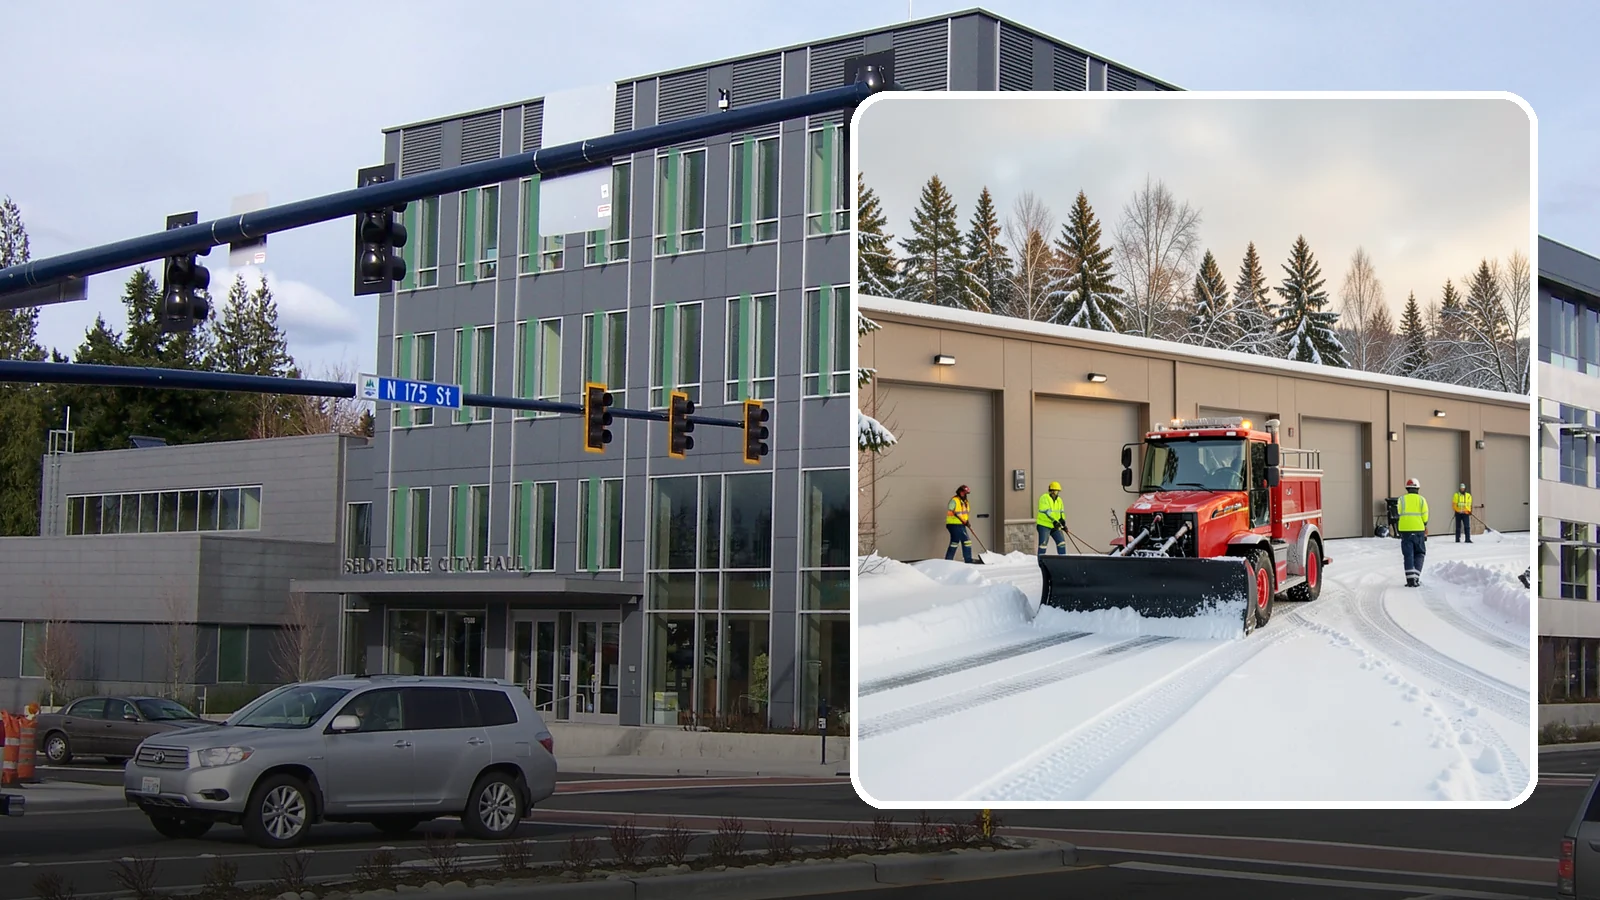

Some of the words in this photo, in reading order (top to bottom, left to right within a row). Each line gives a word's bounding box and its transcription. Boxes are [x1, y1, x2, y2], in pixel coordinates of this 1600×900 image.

[387, 380, 396, 399] N
[405, 382, 427, 403] 175
[436, 386, 451, 405] St
[344, 556, 431, 574] SHORELINE
[438, 556, 475, 572] CITY
[483, 555, 525, 572] HALL
